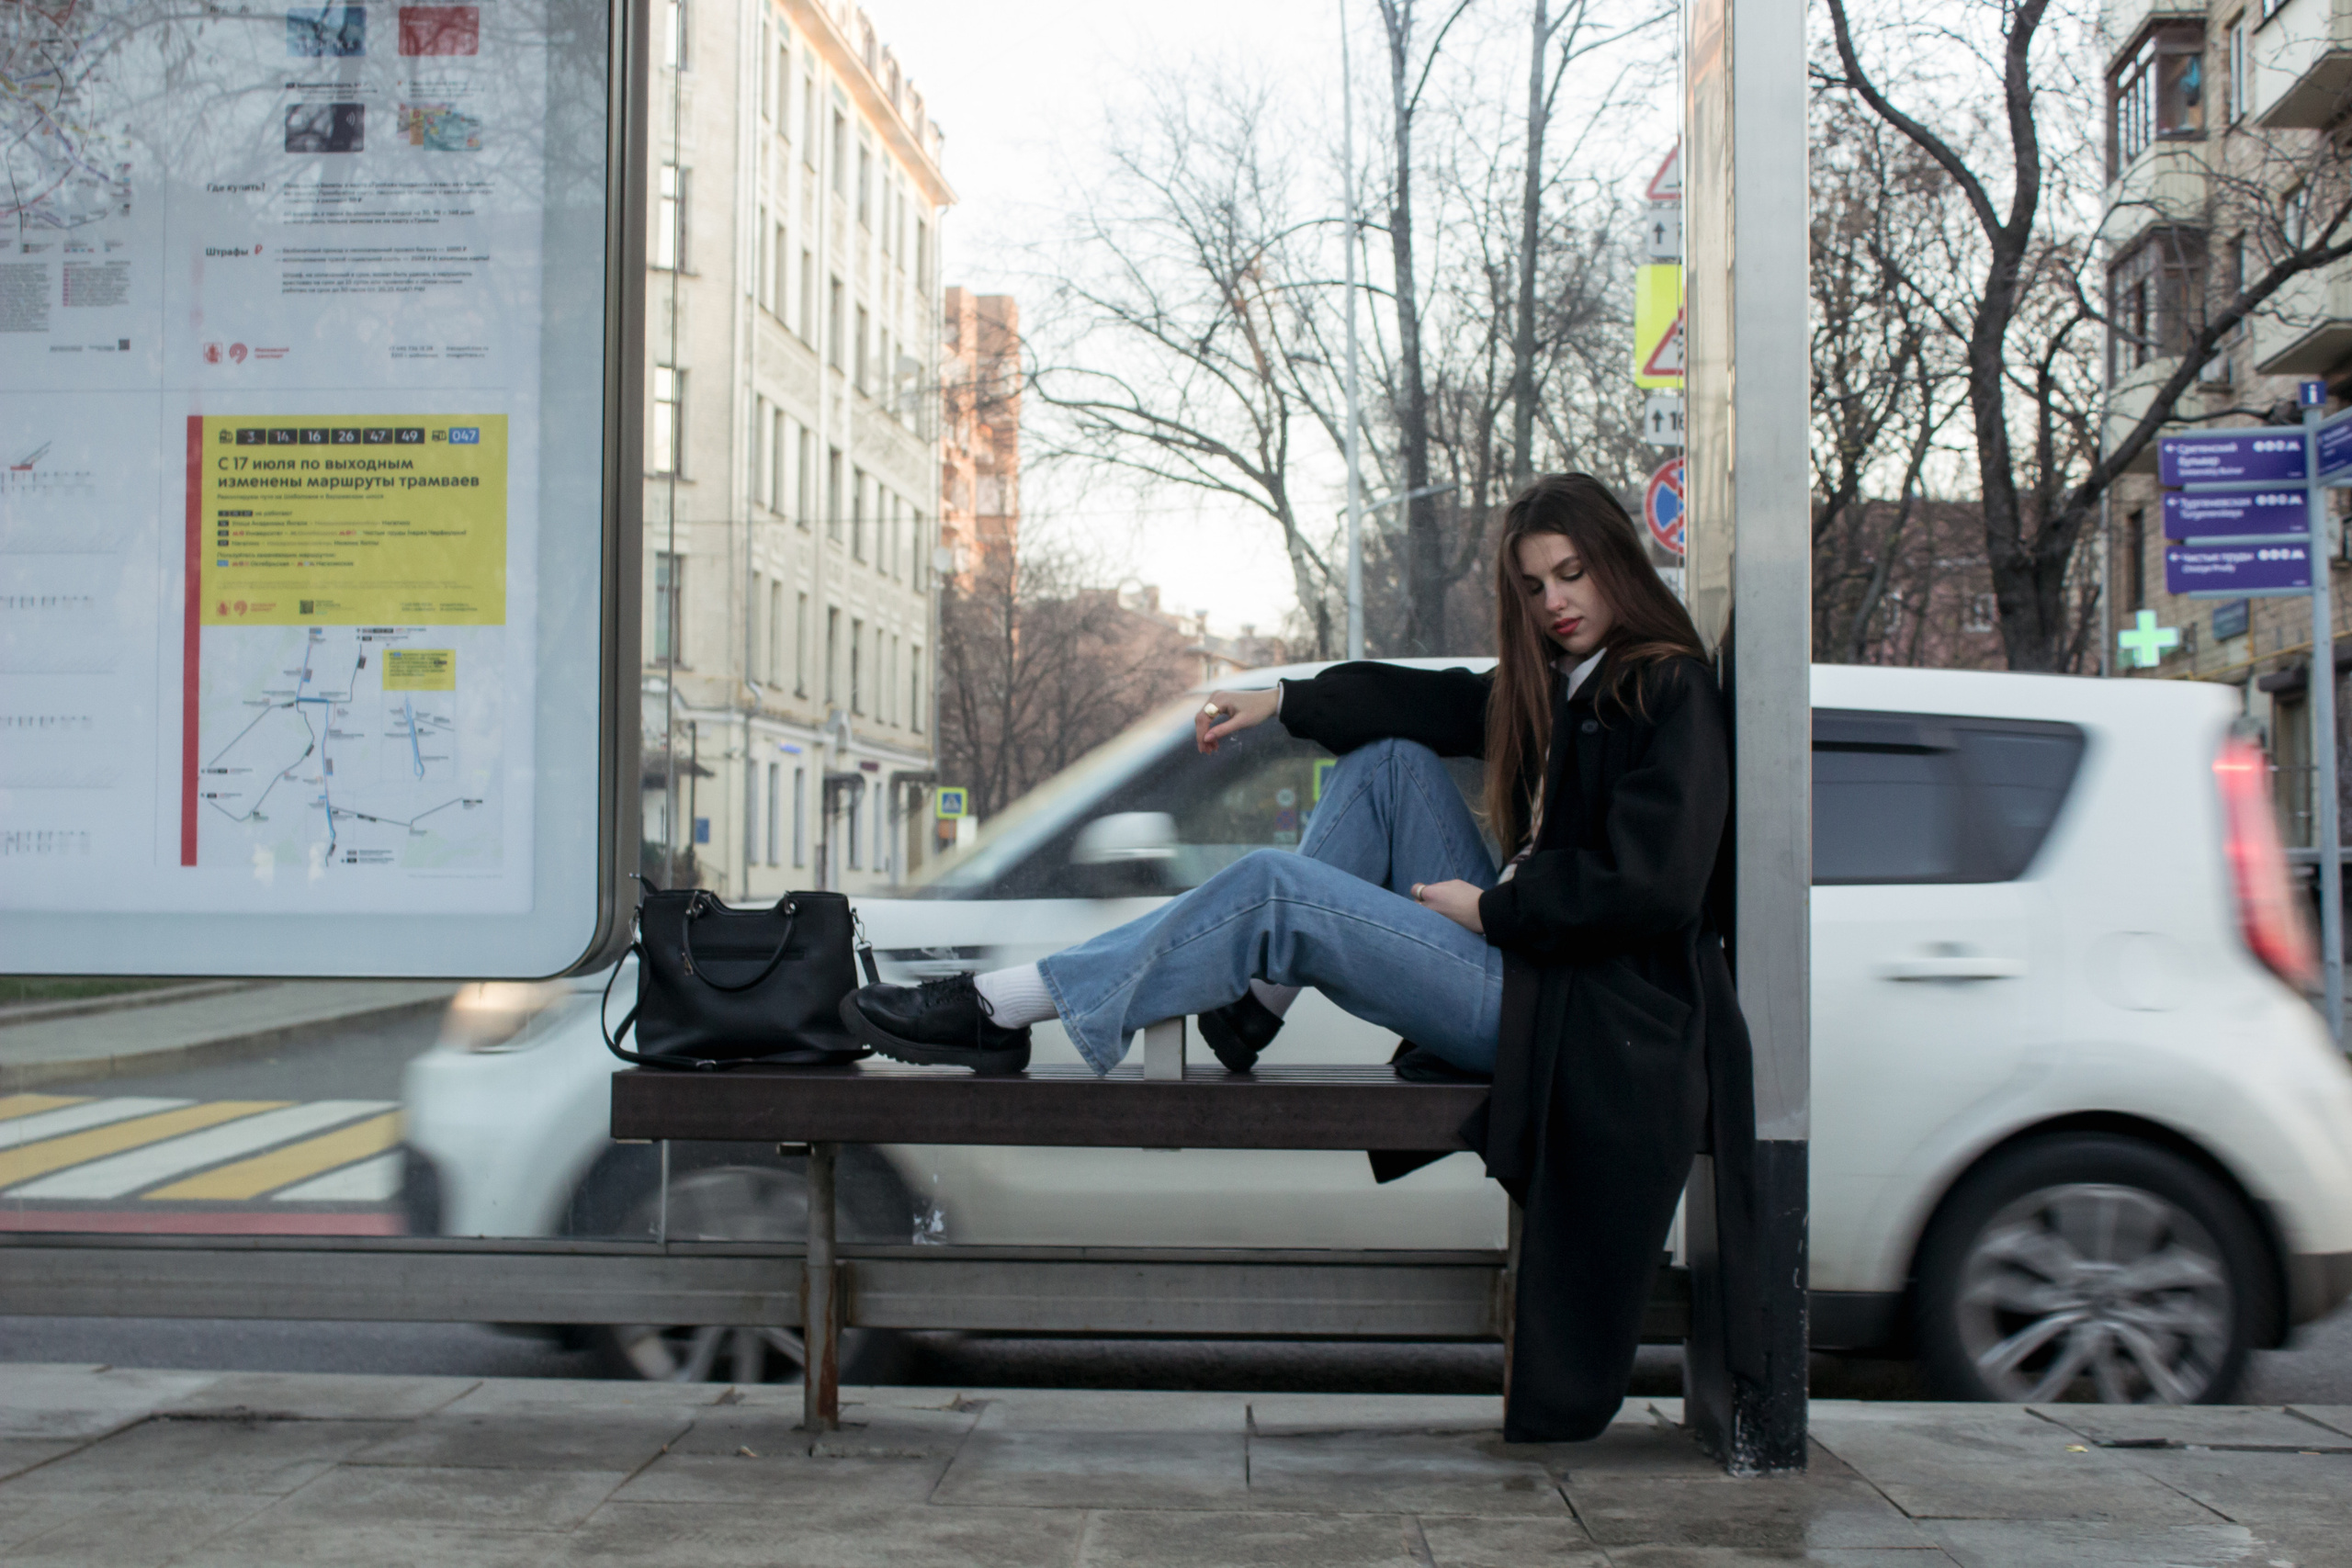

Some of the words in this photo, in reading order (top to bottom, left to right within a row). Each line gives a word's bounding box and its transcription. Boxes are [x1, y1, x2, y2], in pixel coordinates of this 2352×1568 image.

[207, 184, 225, 193] Где
[206, 247, 249, 258] Штрафы
[247, 431, 255, 443] 3
[276, 431, 289, 443] 14
[308, 431, 321, 443] 16
[338, 431, 355, 443] 26
[369, 431, 386, 443] 47
[401, 430, 418, 442] 49
[452, 429, 477, 442] 047
[218, 457, 229, 471] С
[233, 457, 249, 470] 17
[253, 458, 296, 470] июля
[300, 459, 321, 470] по
[325, 458, 413, 472] выходным
[218, 476, 302, 488] изменены
[307, 476, 395, 491] маршруты
[400, 475, 480, 490] трамваев
